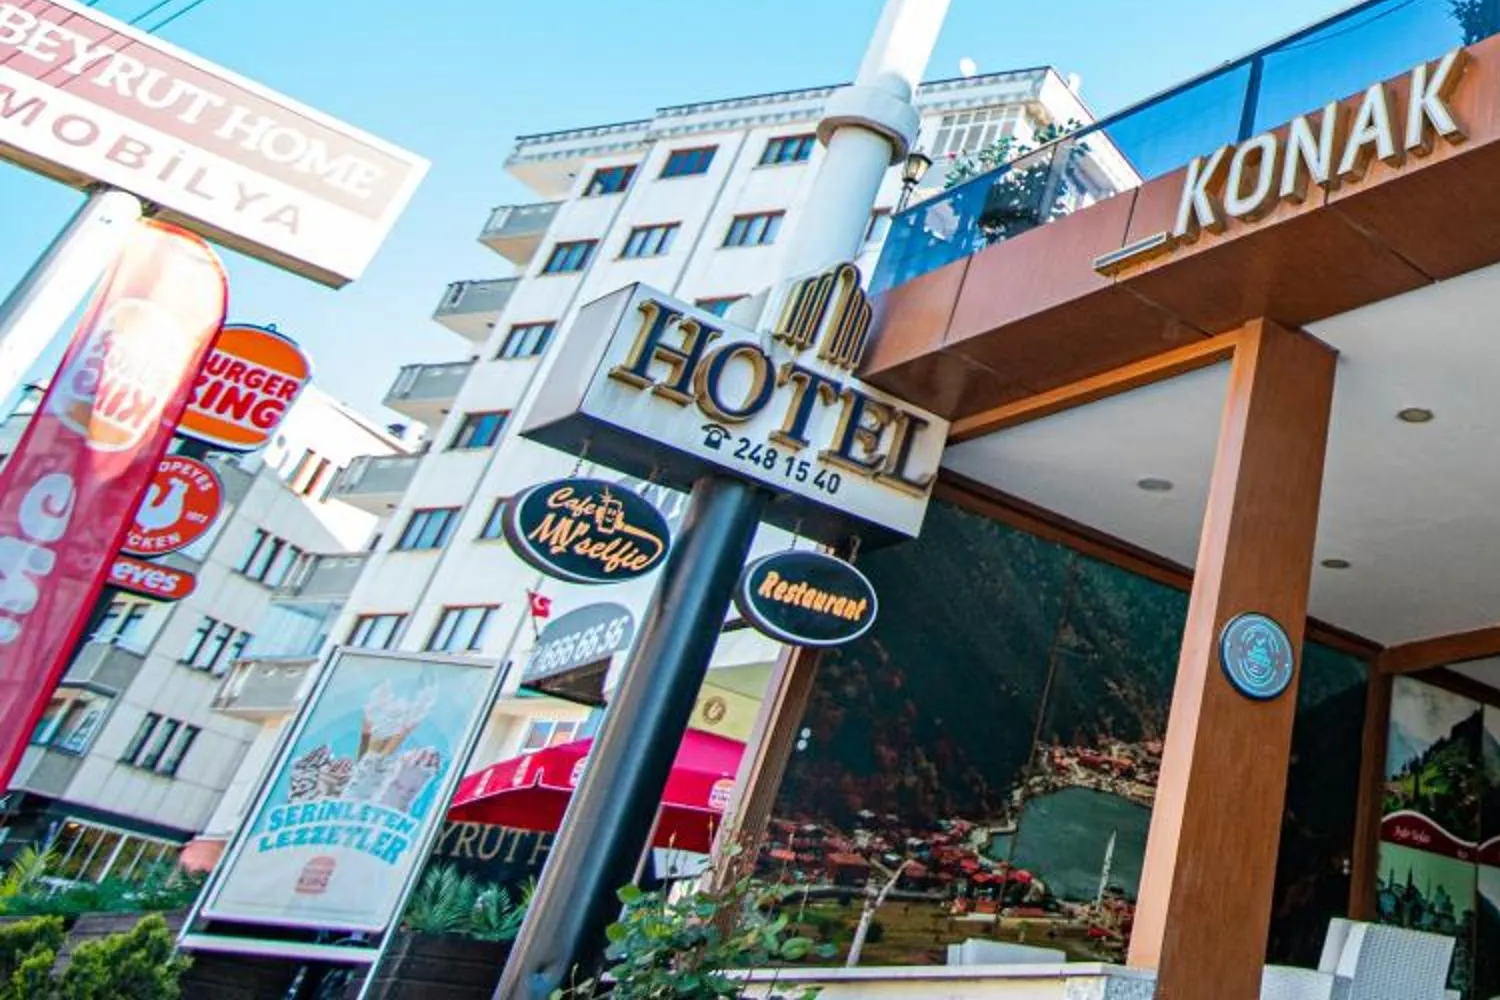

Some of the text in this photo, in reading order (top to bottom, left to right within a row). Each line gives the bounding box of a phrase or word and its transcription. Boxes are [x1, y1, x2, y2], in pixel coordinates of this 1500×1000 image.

[0, 3, 386, 197] BEYRUT HOME
[1173, 47, 1468, 239] KONAK
[202, 352, 298, 401] URGER
[608, 298, 938, 498] HOTEL
[157, 460, 214, 492] OPEYES
[733, 437, 842, 495] 248 15 40
[127, 532, 182, 549] CKEN
[111, 560, 182, 593] eyes
[758, 570, 868, 622] Restaurant
